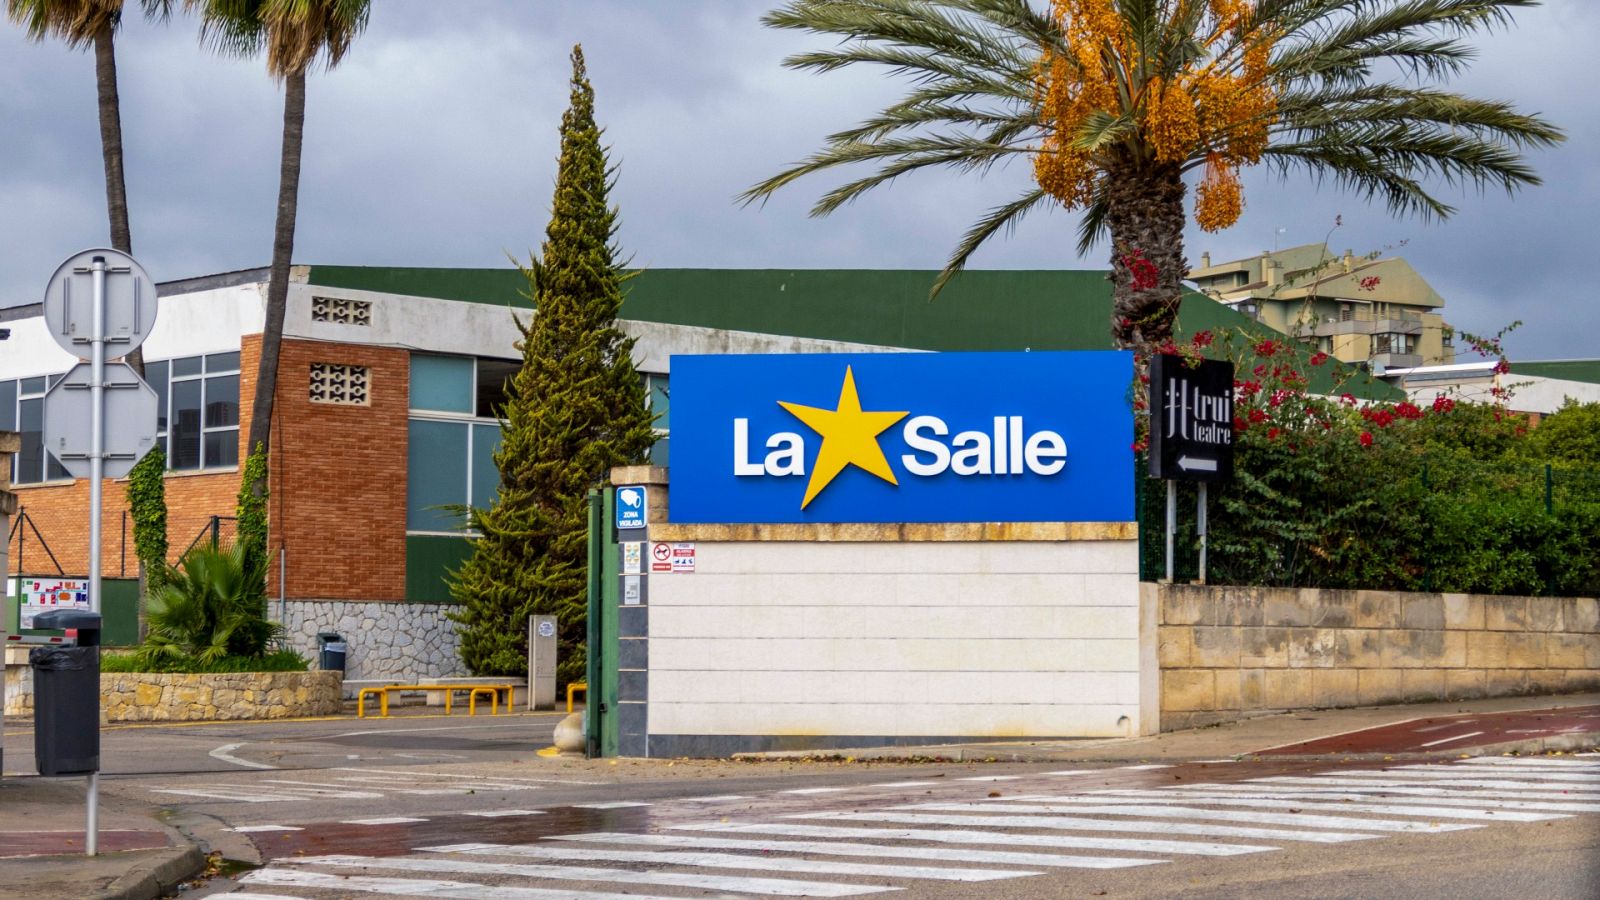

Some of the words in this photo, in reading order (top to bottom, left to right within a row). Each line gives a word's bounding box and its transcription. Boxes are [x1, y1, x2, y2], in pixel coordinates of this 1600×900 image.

[1194, 386, 1230, 423] trui
[733, 417, 805, 476] La
[901, 415, 1067, 476] Salle
[1194, 420, 1231, 445] teatre
